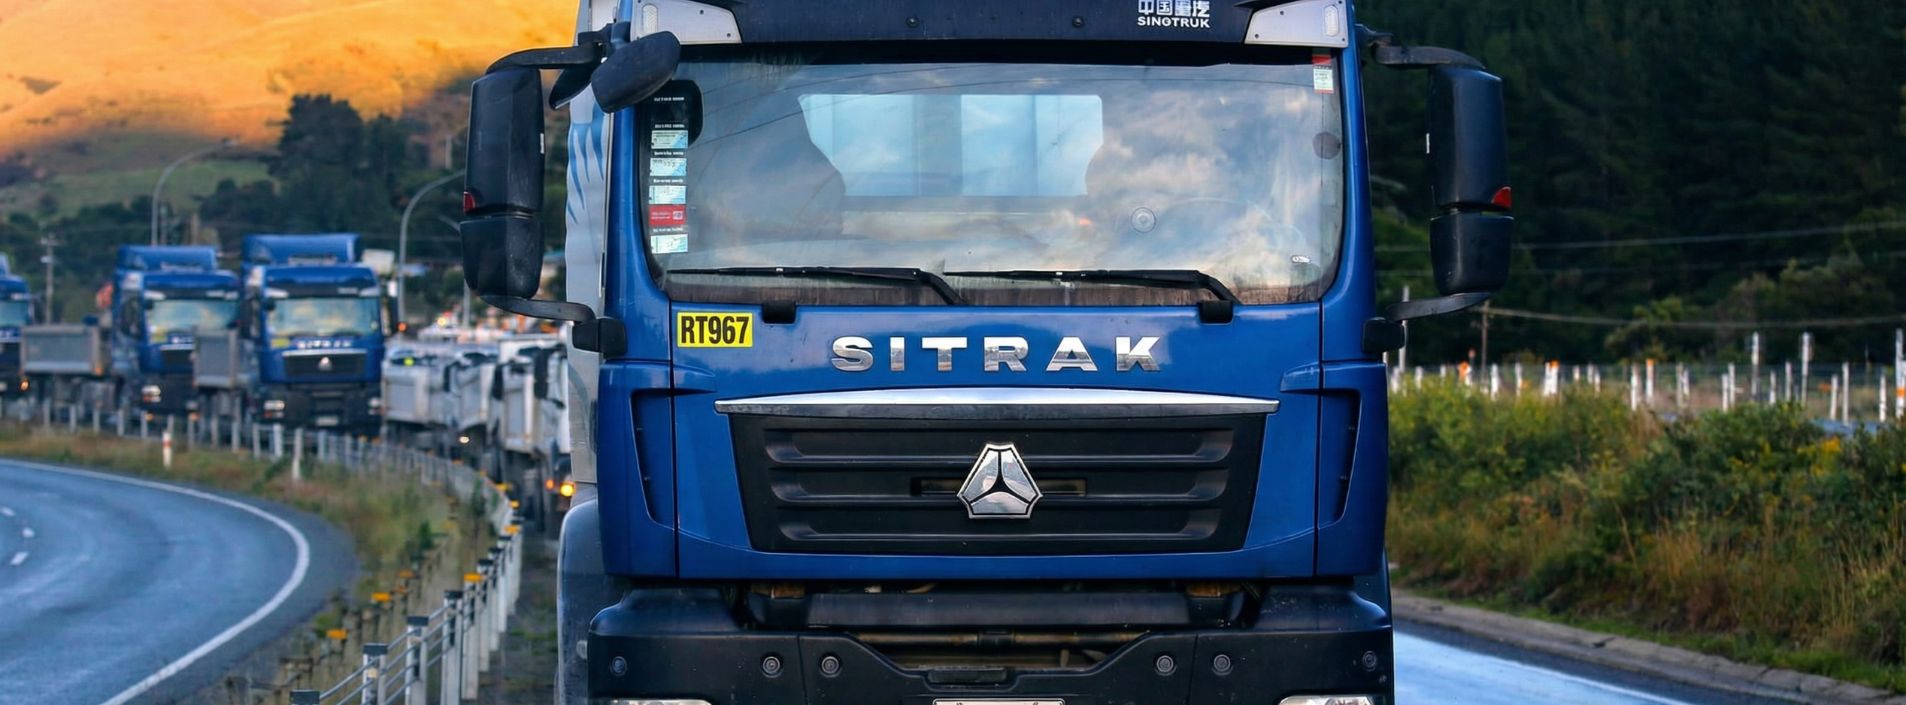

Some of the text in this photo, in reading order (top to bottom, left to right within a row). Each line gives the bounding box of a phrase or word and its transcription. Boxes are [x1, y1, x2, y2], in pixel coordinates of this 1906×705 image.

[1137, 16, 1211, 28] SINOTRUK
[681, 315, 749, 344] RT967
[831, 336, 1160, 371] SITRAK
